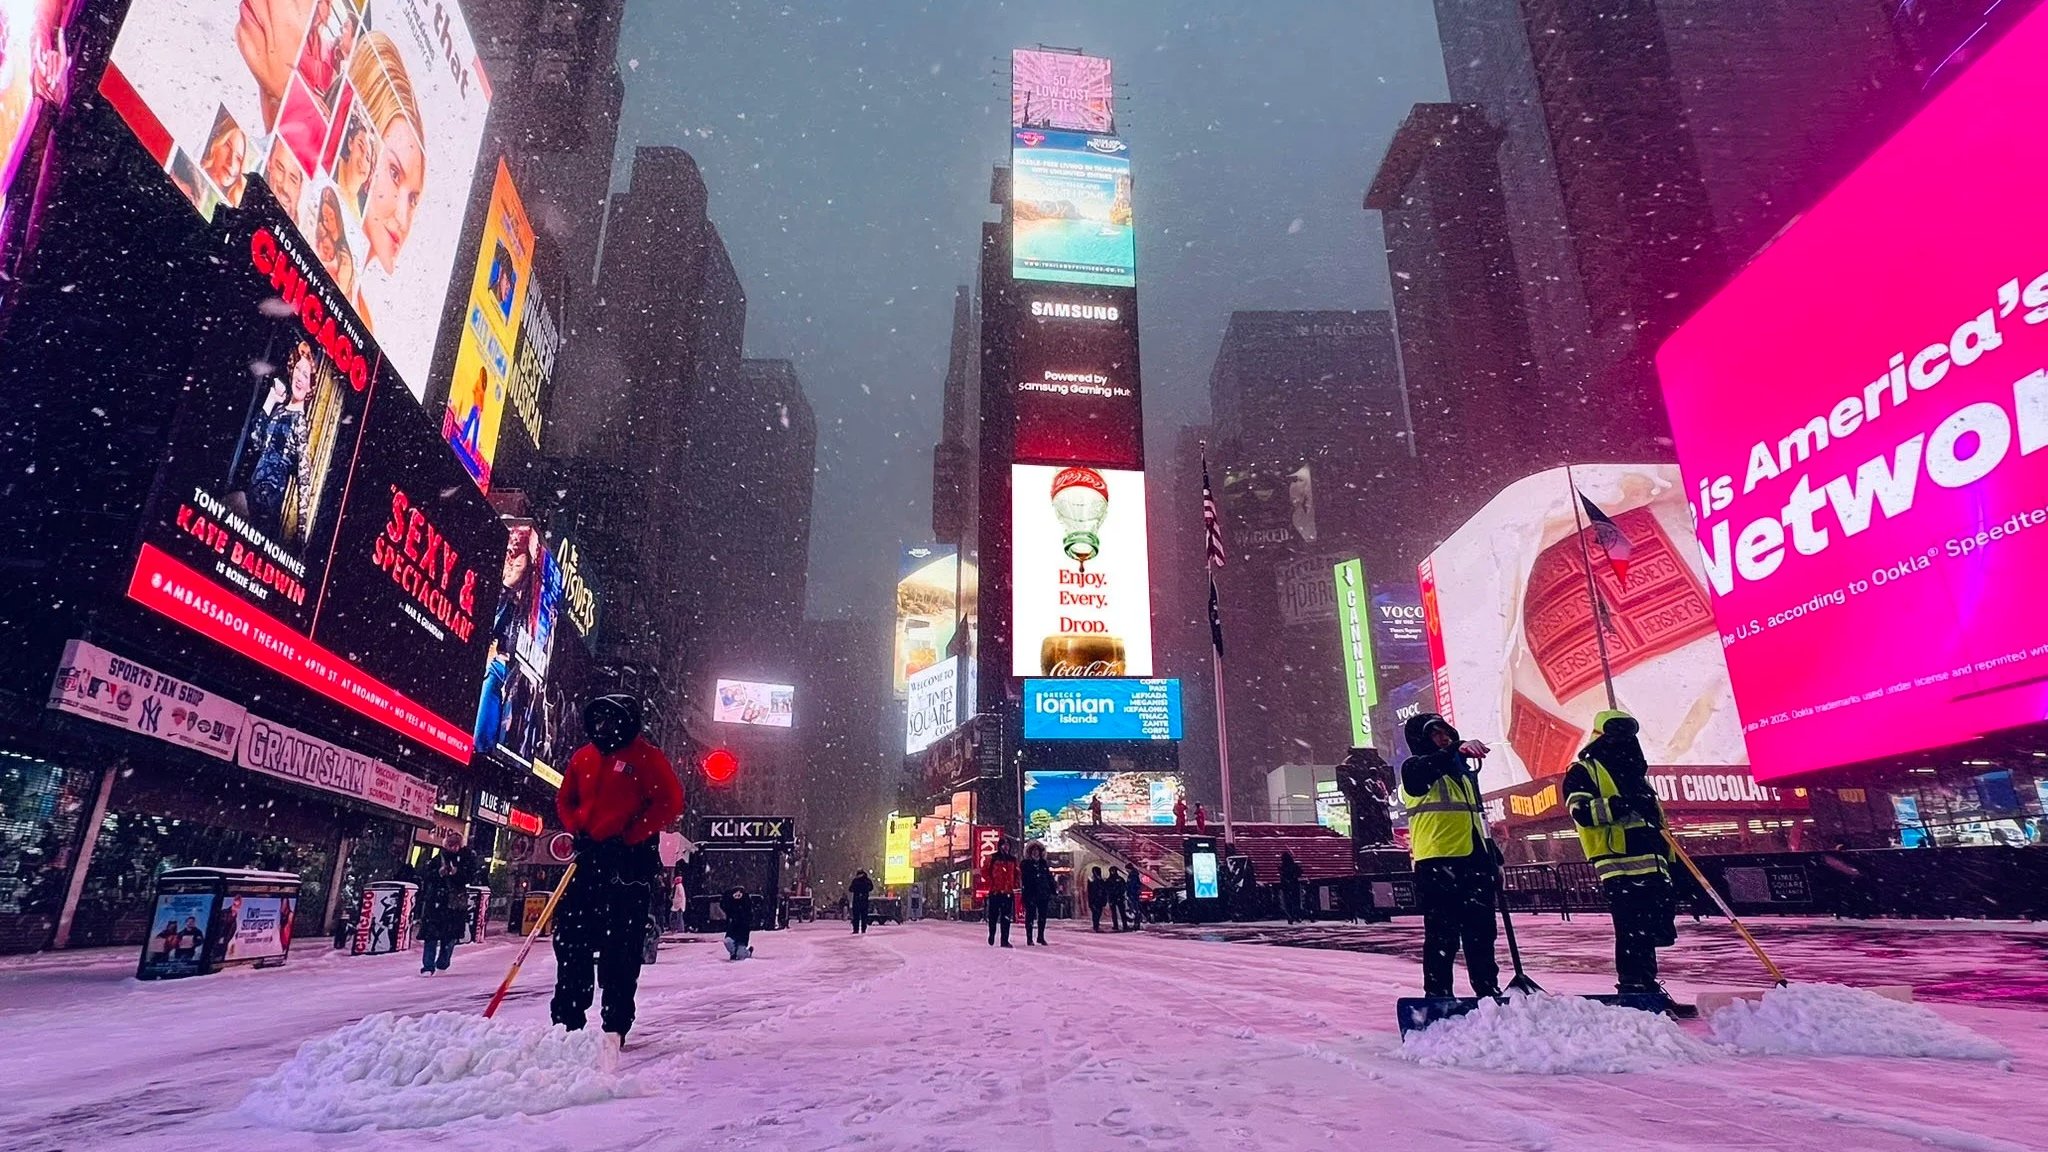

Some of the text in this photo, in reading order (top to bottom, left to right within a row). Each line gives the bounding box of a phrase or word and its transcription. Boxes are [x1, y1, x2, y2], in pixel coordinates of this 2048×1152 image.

[433, 2, 469, 101] that
[1053, 75, 1067, 87] 50
[274, 224, 364, 350] BROADWAY'S SURE THING
[251, 228, 368, 392] CHICAGO
[1031, 302, 1119, 321] SAMSUNG
[519, 336, 544, 402] BEST
[1044, 371, 1108, 385] Powered by
[508, 361, 543, 450] MUSICAL
[1018, 382, 1068, 395] Samsung
[1070, 384, 1112, 398] Gaming
[1699, 271, 2048, 519] is America's
[193, 487, 226, 520] TONY
[263, 538, 306, 578] NOMINEE
[1234, 528, 1289, 546] WICKED
[176, 503, 306, 606] KATE BALDWIN
[215, 560, 269, 600] IS ROXIE HART
[459, 569, 476, 617] &
[1059, 569, 1107, 588] Enjoy.
[1059, 591, 1108, 609] Every.
[1638, 599, 1702, 636] HERSHEY'S
[1736, 619, 1764, 640] U.S.
[1767, 589, 1845, 628] according
[1849, 580, 1868, 596] to
[163, 580, 250, 636] AMBASSADOR
[252, 627, 295, 661] THEATRE
[305, 658, 326, 677] 49TH
[327, 668, 338, 683] ST.
[341, 679, 352, 690] AT
[351, 681, 389, 710] BROADWAY
[394, 706, 404, 719] NO
[405, 710, 419, 727] FEES
[1347, 590, 1372, 735] CANNABIS
[109, 658, 204, 707] SPORTS FAN SHOP
[911, 668, 954, 692] WELCOME TO
[927, 685, 953, 706] TIMES
[1862, 688, 1883, 701] used
[1951, 664, 1972, 677] and
[909, 701, 953, 736] SQUARE
[1036, 692, 1114, 713] Ionian
[1059, 713, 1098, 724] Islands
[480, 790, 499, 811] BLUE
[711, 821, 782, 837] KLIKTIX
[241, 918, 275, 933] strangers
[355, 892, 374, 952] CHICAGO
